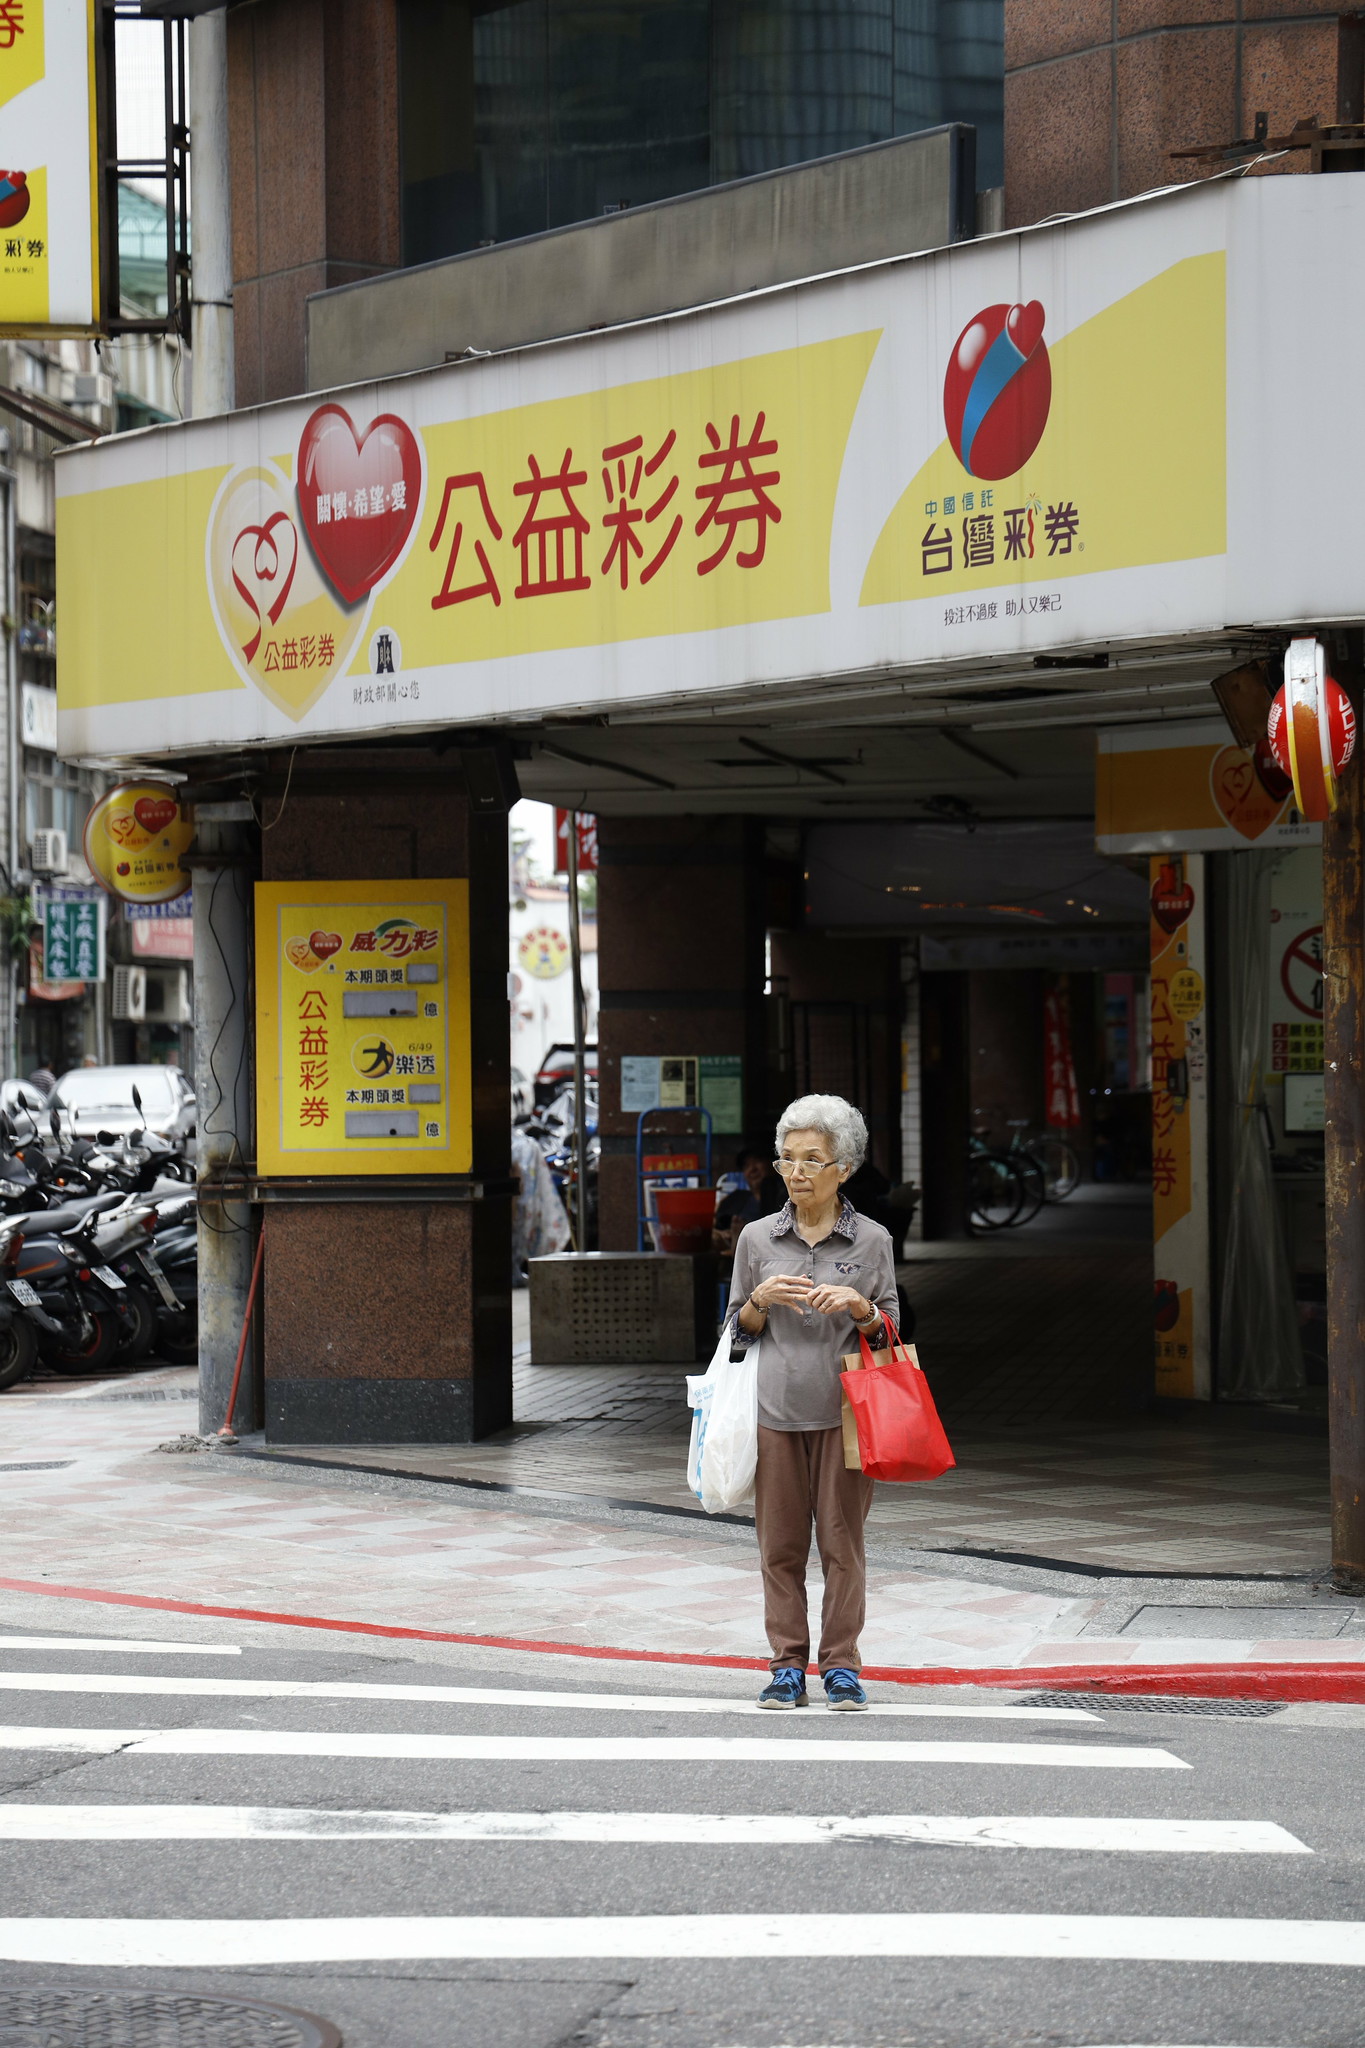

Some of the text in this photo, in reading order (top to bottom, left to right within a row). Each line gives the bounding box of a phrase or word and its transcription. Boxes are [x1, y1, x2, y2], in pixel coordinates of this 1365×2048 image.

[428, 410, 782, 610] 公益彩券
[925, 489, 993, 518] 中國信託
[921, 501, 1080, 576] 台灣彩券
[944, 593, 1062, 627] 投注不過度 助人又樂己
[264, 633, 335, 673] 公益彩券
[353, 680, 420, 705] 財政部關心您
[349, 928, 439, 956] 威力彩
[344, 969, 404, 985] 本期頭獎
[424, 1002, 439, 1017] 億
[298, 990, 329, 1127] 公益彩券
[408, 1042, 433, 1052] 6/49
[346, 1089, 406, 1105] 本期頭獎
[425, 1122, 440, 1137] 億
